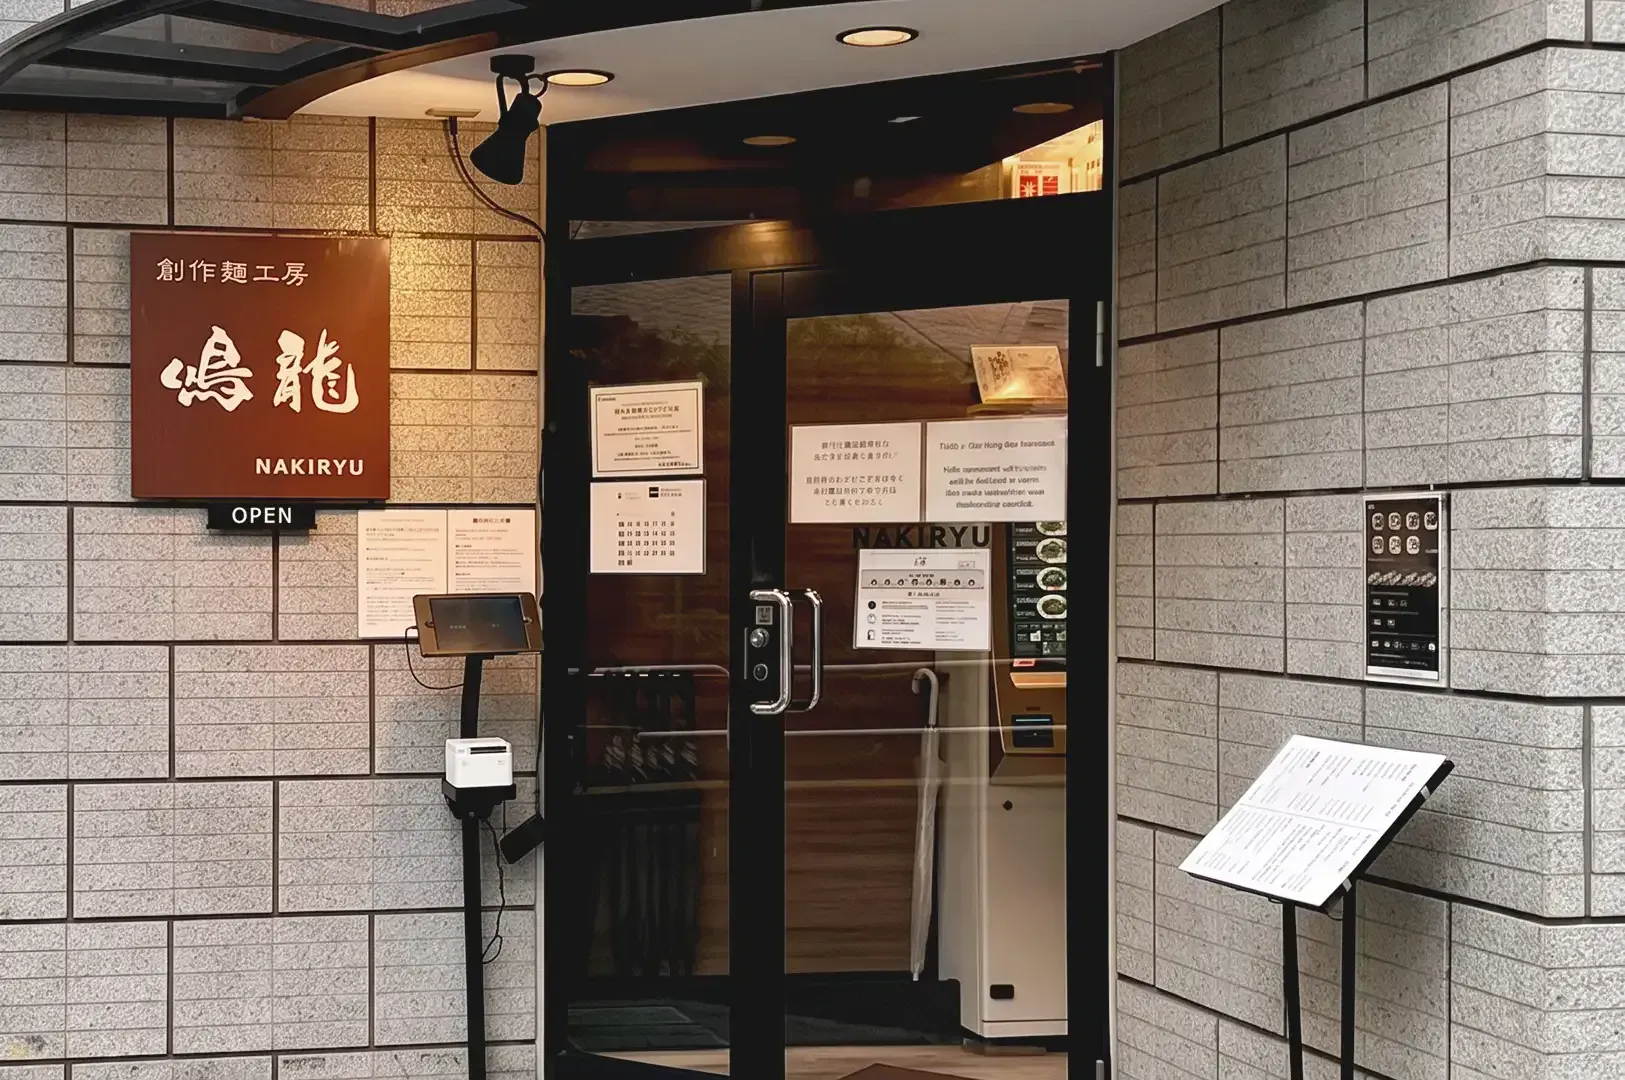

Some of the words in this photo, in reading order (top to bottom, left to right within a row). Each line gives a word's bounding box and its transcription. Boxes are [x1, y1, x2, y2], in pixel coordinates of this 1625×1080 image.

[156, 257, 309, 287] 創作麺工房
[160, 325, 359, 414] 鳴龍
[255, 458, 364, 476] NAKIRYU
[231, 506, 292, 524] OPEN
[853, 525, 990, 548] NAKIRYU
